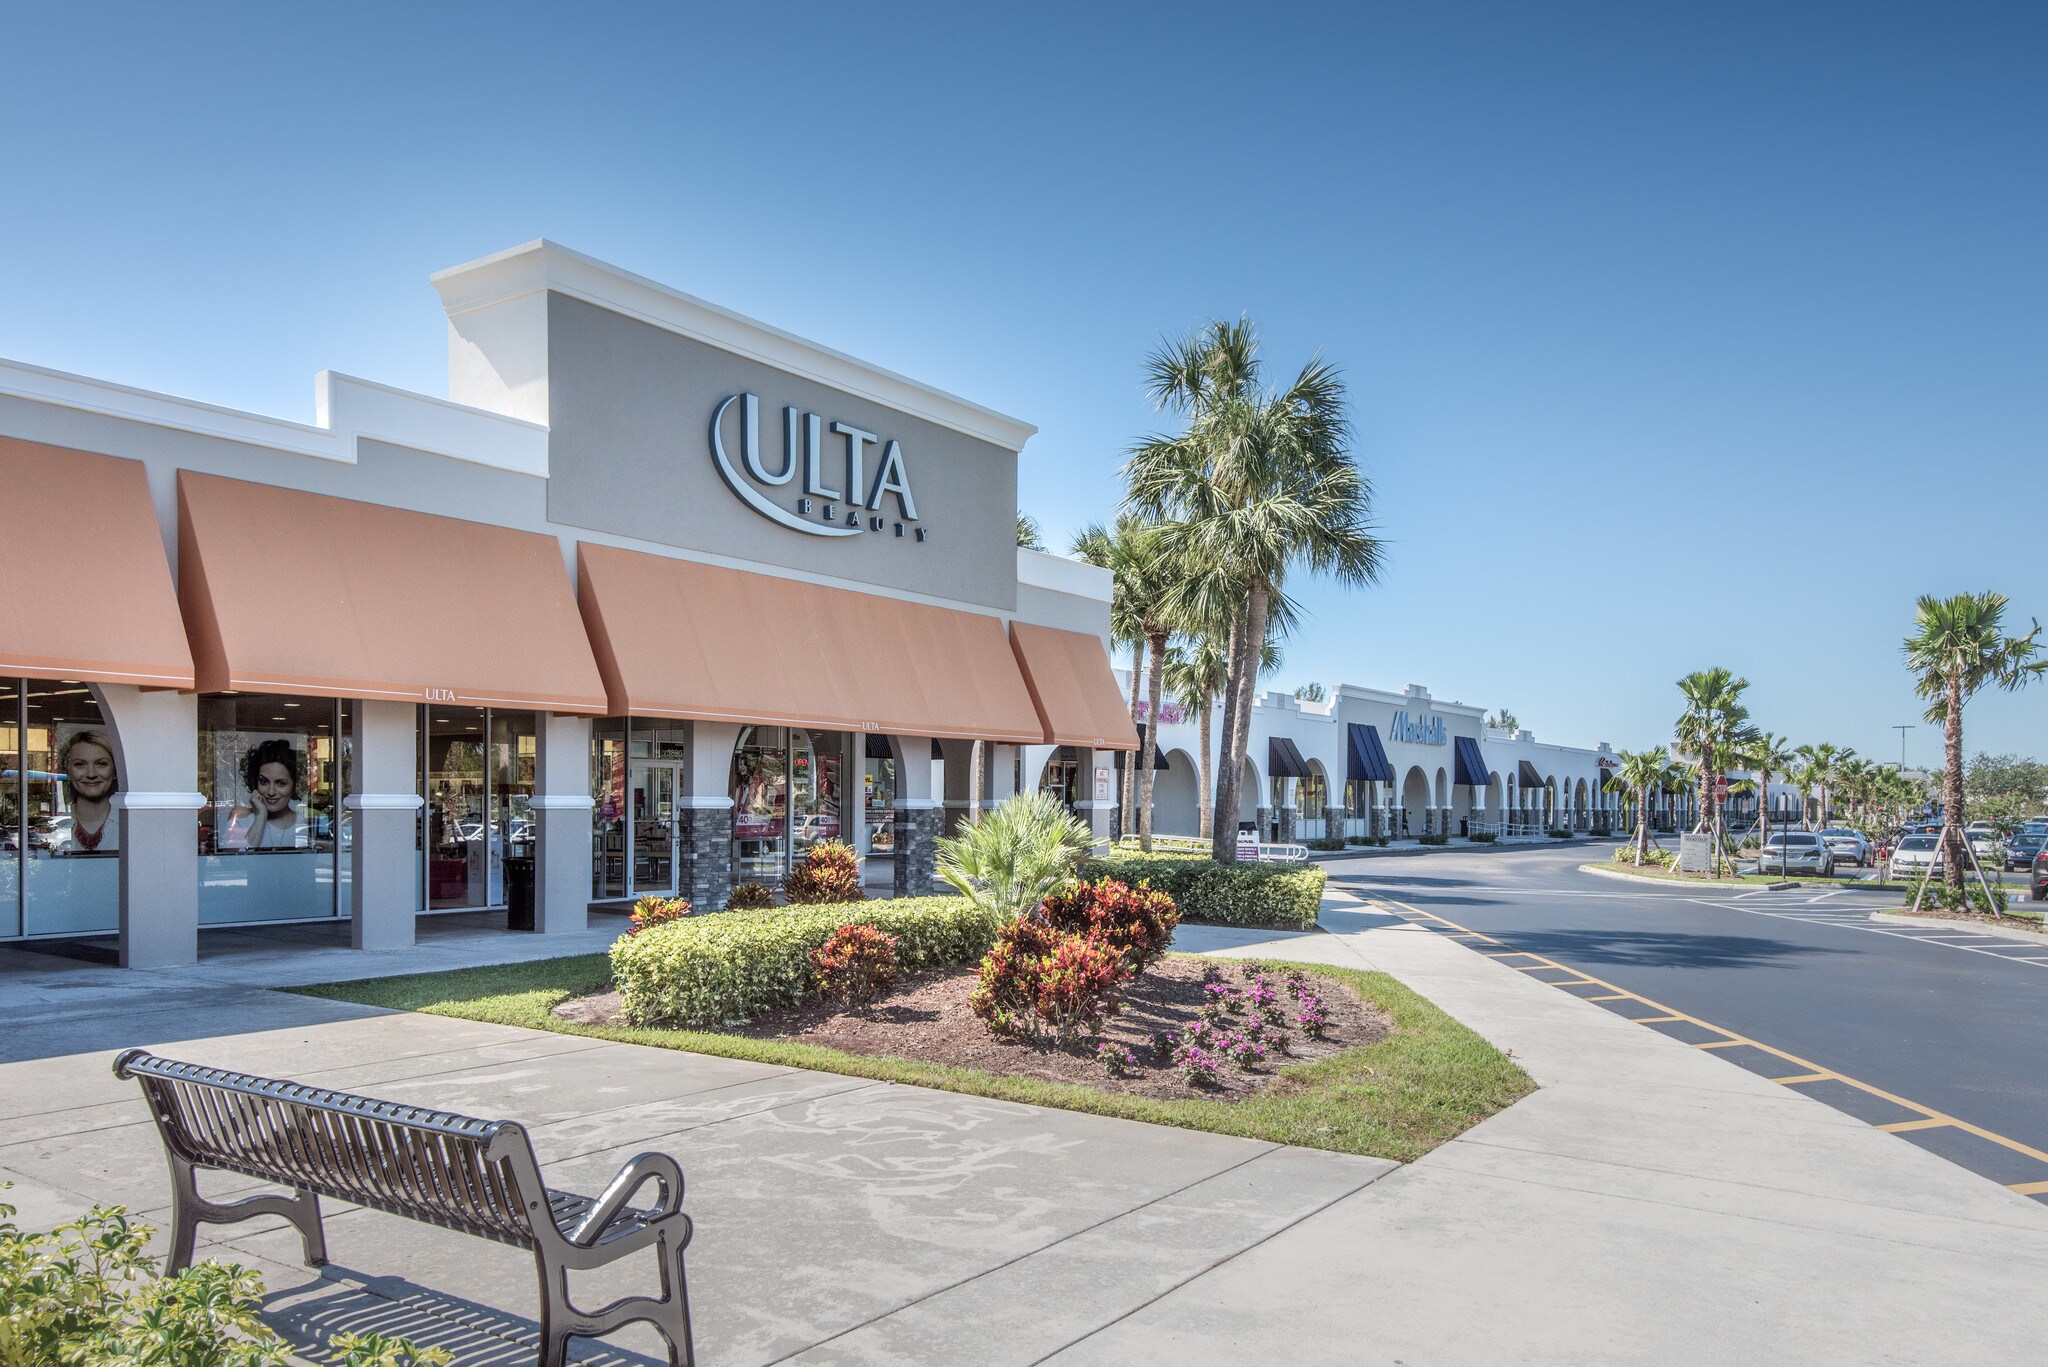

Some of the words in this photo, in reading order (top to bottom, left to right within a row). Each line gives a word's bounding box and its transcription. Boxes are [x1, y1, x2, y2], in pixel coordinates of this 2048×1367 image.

[740, 393, 919, 521] ULTA
[798, 498, 929, 543] BEAUTY
[425, 687, 456, 702] ULTA
[862, 721, 880, 731] ULTA
[1390, 711, 1447, 746] Marshalls
[794, 758, 809, 767] OPEN
[1716, 784, 1727, 795] STOP
